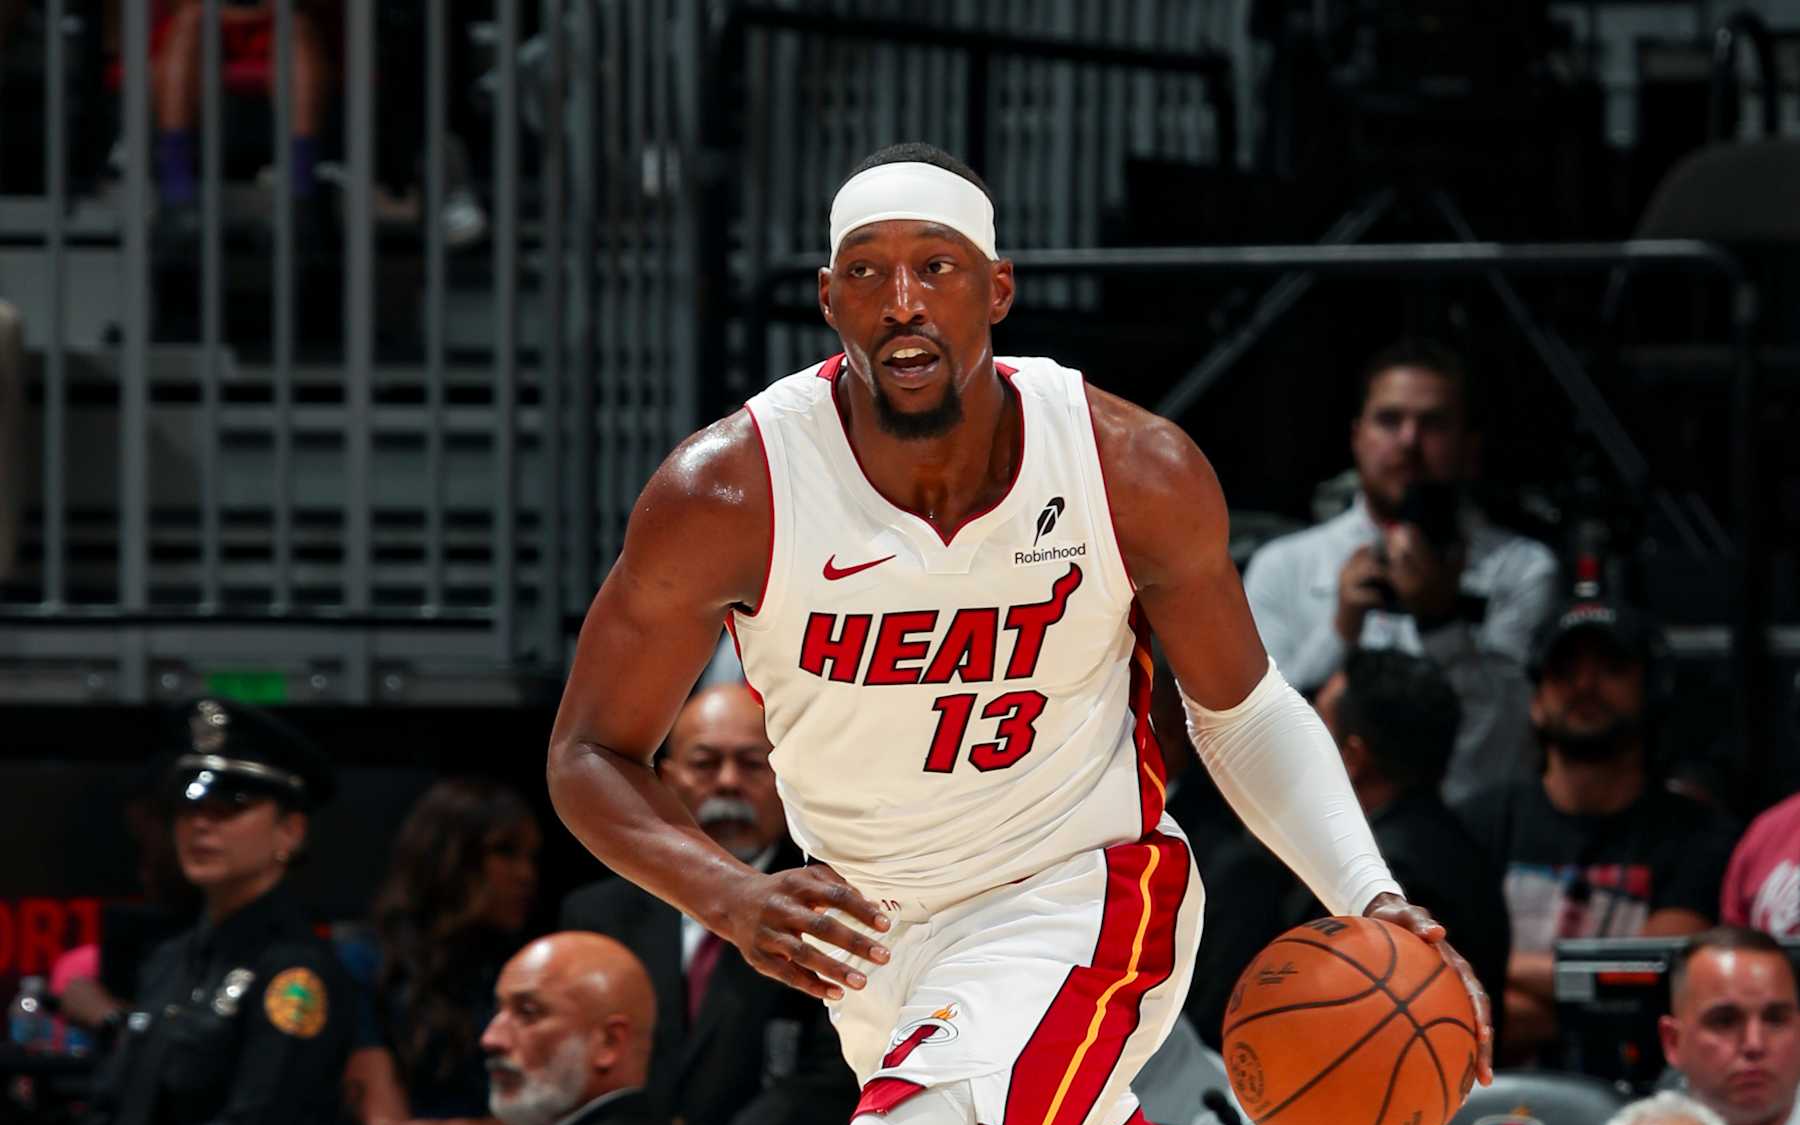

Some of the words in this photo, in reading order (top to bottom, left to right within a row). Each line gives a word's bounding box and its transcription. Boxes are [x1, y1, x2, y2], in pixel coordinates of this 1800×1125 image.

[1014, 542, 1087, 565] Robinhood
[798, 561, 1084, 687] HEAT
[922, 689, 1049, 774] 13
